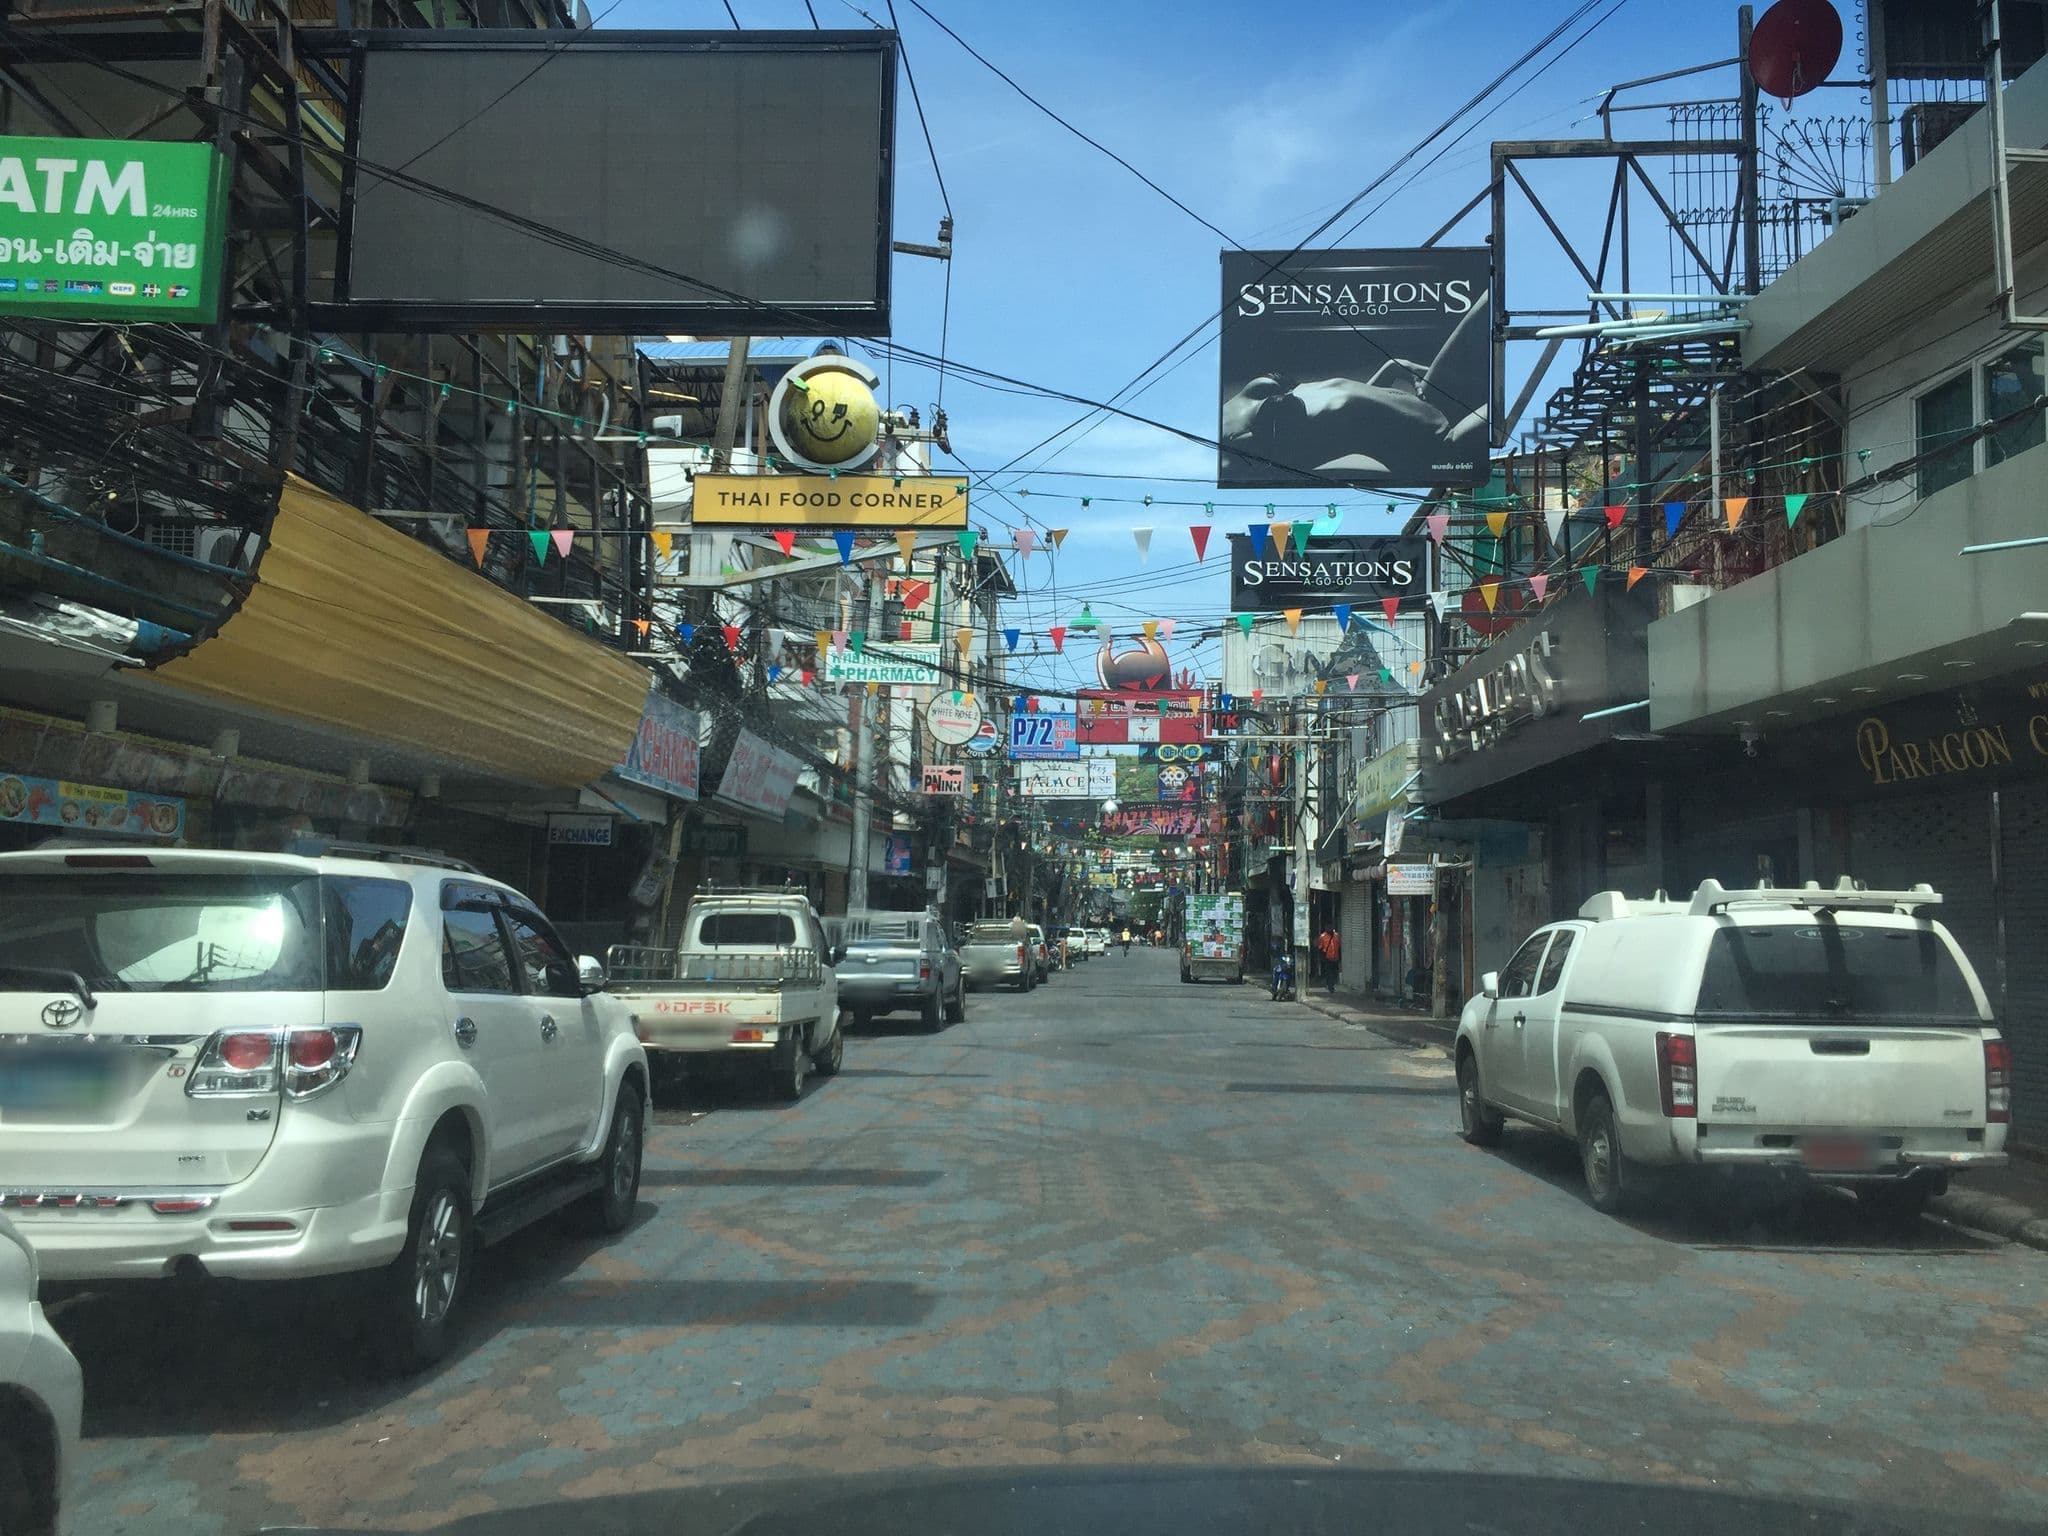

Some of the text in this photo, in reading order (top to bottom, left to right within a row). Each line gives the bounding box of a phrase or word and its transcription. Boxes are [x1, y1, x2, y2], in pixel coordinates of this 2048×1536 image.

[0, 157, 198, 218] ATM 24HRS
[1238, 279, 1472, 317] SENSATIONS
[717, 492, 944, 509] THAI FOOD CORNER
[1243, 560, 1413, 586] SENSATIONS
[846, 667, 936, 682] PHARMACY
[1013, 718, 1053, 745] P72
[1856, 718, 2013, 784] PARAGON
[551, 828, 610, 843] EXCHANGE
[673, 1002, 732, 1013] DFSK
